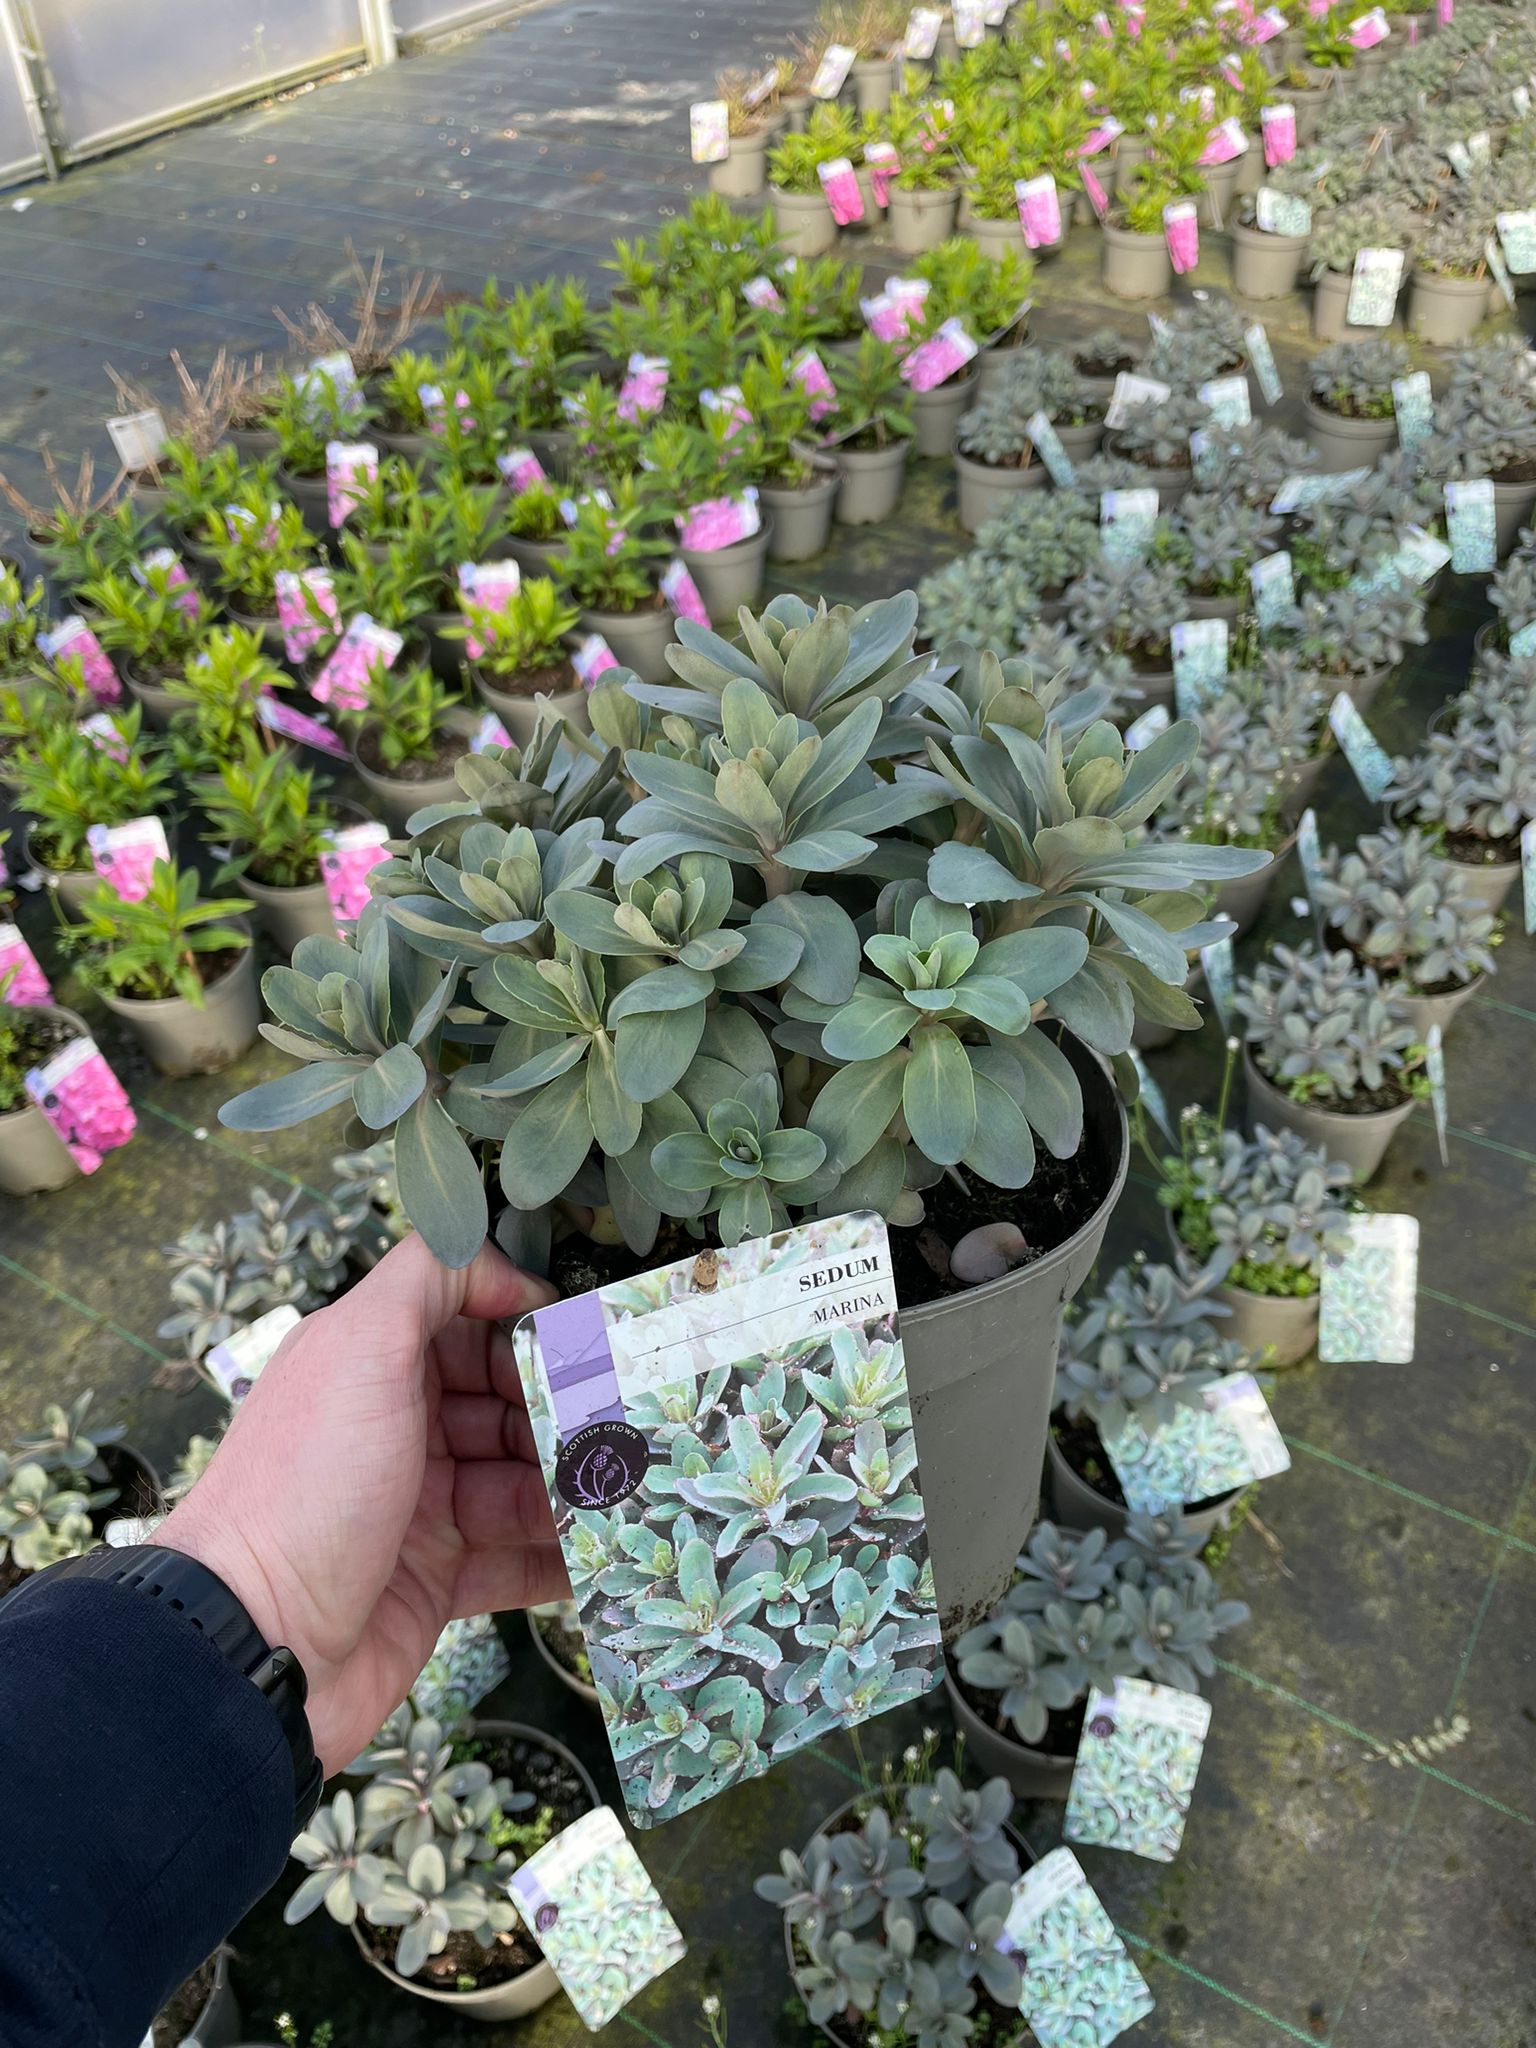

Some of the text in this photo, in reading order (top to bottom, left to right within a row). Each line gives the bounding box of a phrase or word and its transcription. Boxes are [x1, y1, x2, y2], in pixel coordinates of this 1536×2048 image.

[799, 1256, 879, 1292] SEDUM
[813, 1292, 884, 1323] MARINA
[562, 1424, 639, 1462] SCOTTISH GROWN
[580, 1496, 611, 1506] SINCE
